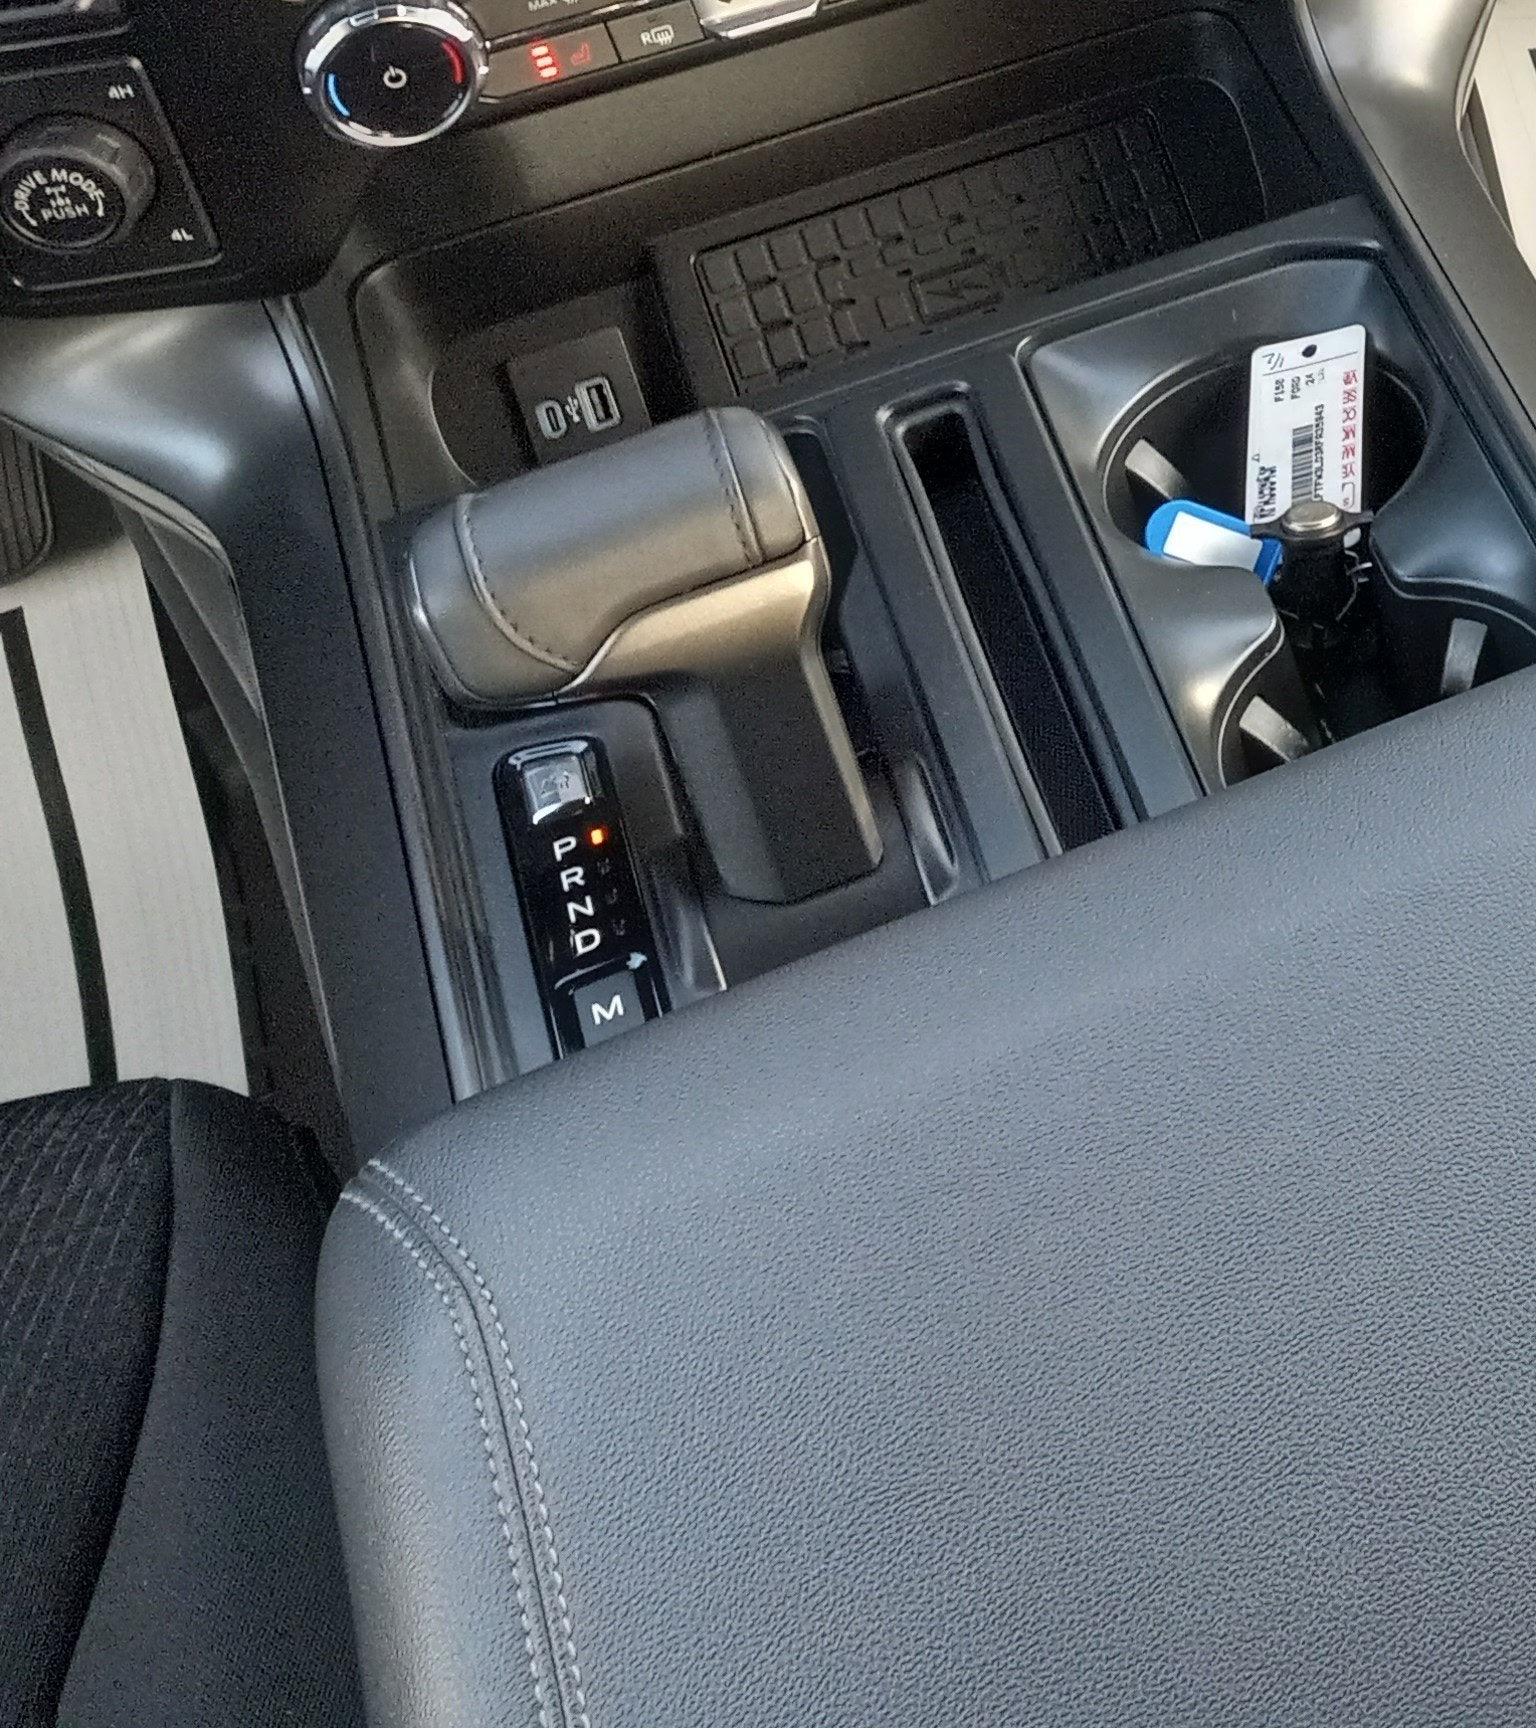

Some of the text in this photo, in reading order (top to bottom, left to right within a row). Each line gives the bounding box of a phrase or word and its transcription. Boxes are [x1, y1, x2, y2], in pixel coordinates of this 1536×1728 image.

[107, 84, 135, 100] 4H
[13, 167, 105, 212] DRIVE MODE
[41, 203, 90, 223] PUSH
[170, 227, 195, 243] 4L
[552, 835, 602, 959] P R N D
[591, 994, 625, 1027] M
